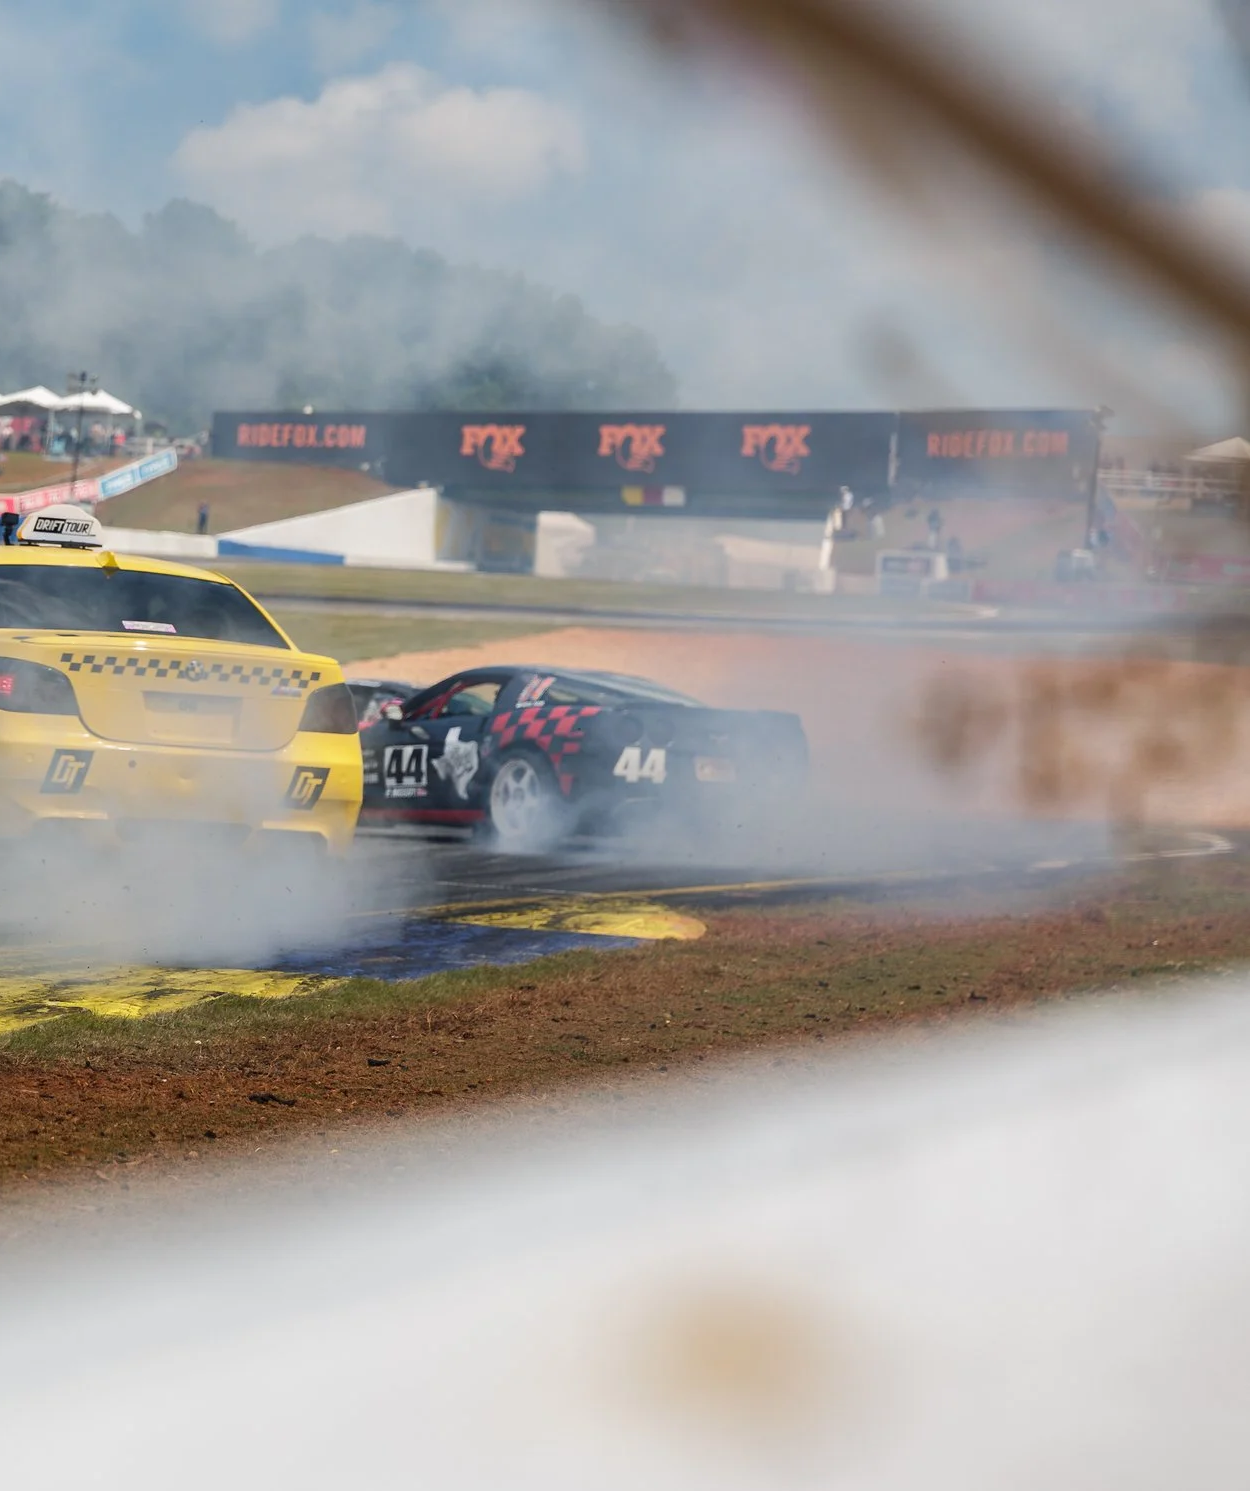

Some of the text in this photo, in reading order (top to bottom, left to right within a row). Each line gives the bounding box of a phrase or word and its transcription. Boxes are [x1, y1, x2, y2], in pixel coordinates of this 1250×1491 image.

[237, 423, 366, 448] RIDEFOX.COM
[460, 424, 526, 464] FOX
[597, 424, 666, 464] FOX
[741, 424, 811, 464] FOX
[35, 518, 91, 534] DRIFT TOUR
[51, 754, 86, 790] DT
[387, 749, 424, 784] 44
[613, 746, 667, 784] 44
[291, 771, 323, 806] DT
